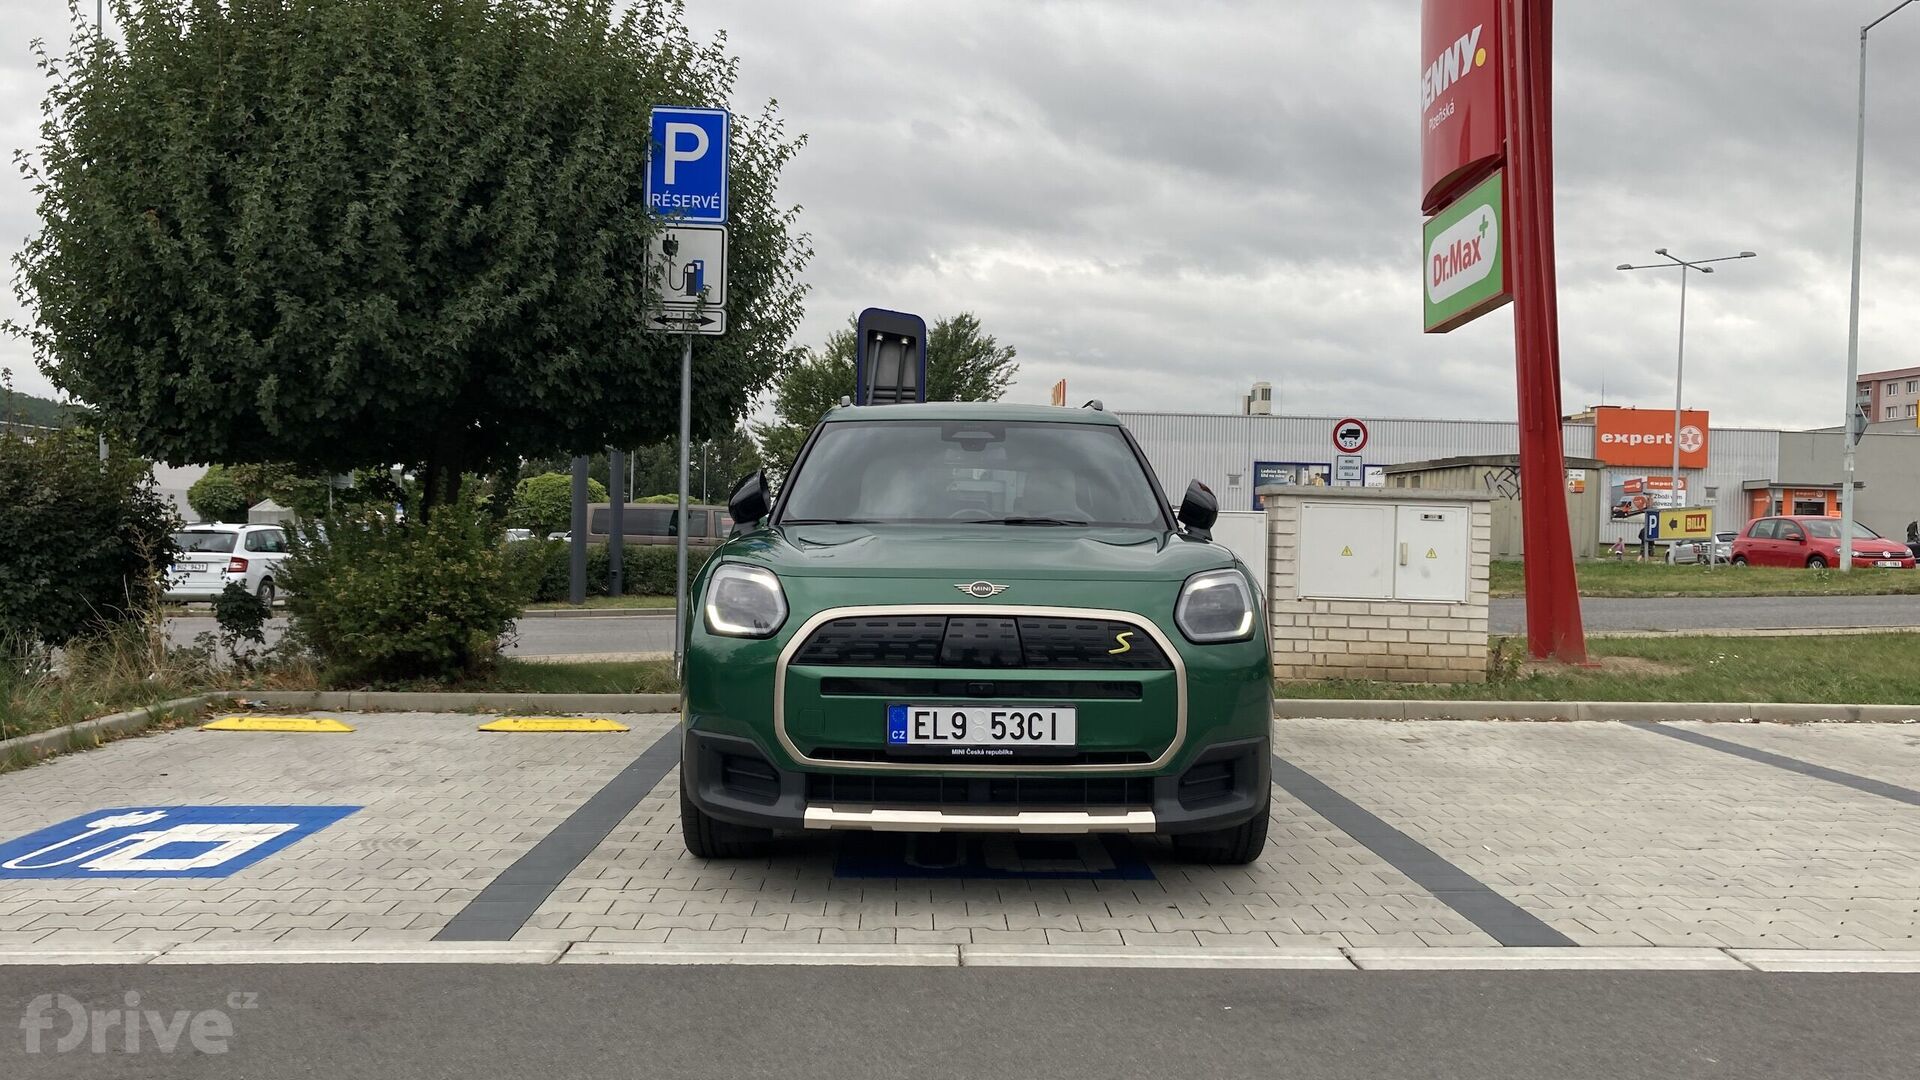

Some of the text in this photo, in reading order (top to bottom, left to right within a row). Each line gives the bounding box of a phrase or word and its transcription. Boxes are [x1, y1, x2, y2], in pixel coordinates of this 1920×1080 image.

[664, 122, 709, 185] P
[651, 190, 720, 209] RÉSERVÉ
[1433, 235, 1481, 288] Dr.Max
[1601, 433, 1673, 446] expert
[1648, 515, 1657, 535] P
[1686, 517, 1706, 531] BILLA
[891, 730, 906, 740] CZ
[914, 711, 1057, 741] EL9 53CI
[966, 747, 985, 755] Česká
[985, 748, 1013, 756] republika
